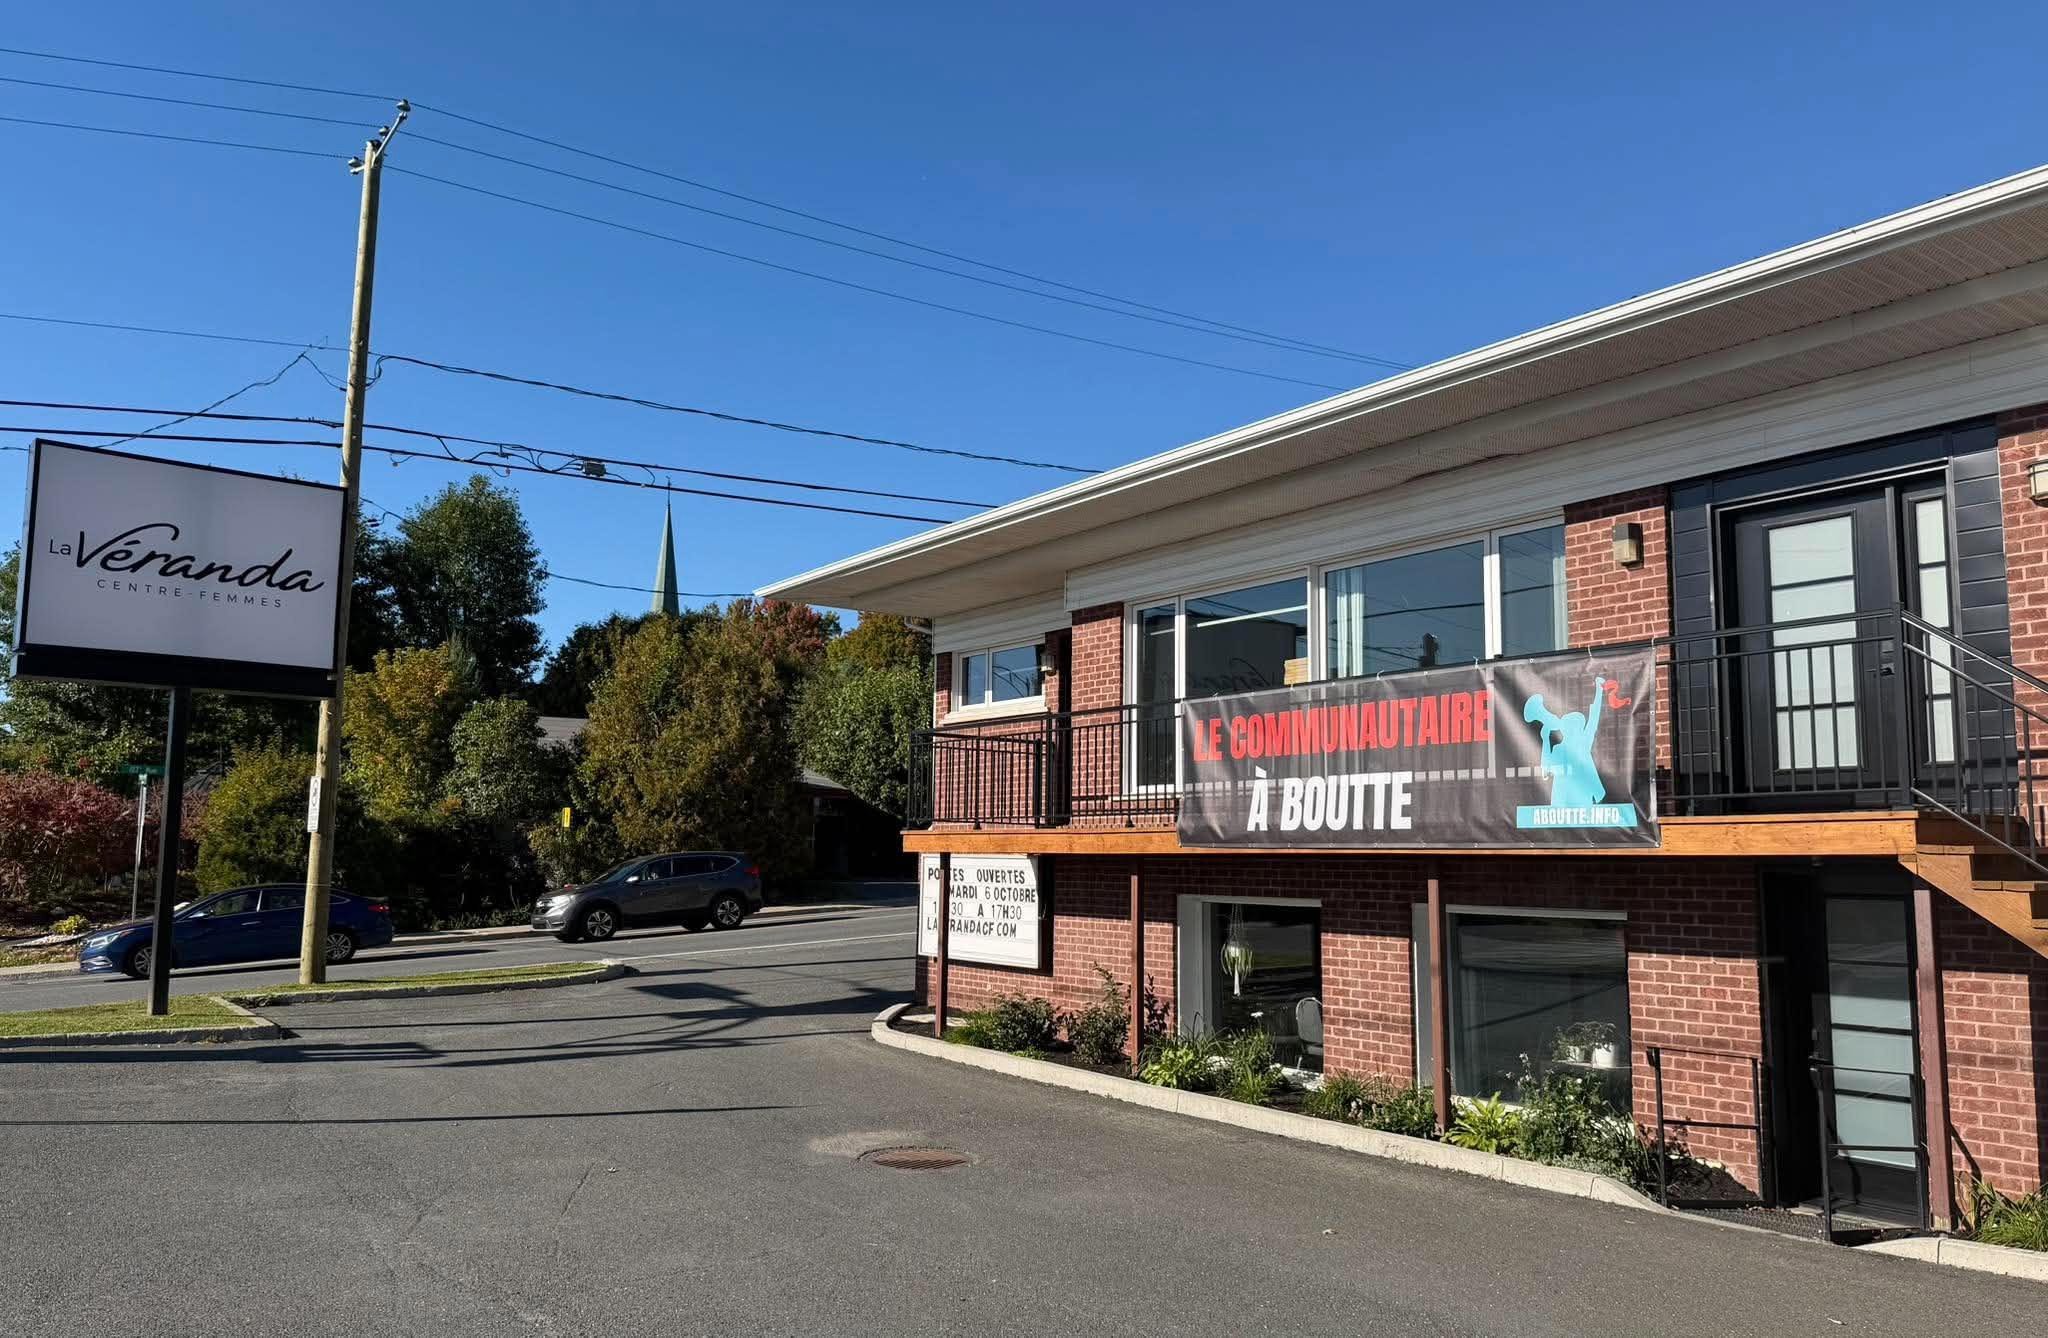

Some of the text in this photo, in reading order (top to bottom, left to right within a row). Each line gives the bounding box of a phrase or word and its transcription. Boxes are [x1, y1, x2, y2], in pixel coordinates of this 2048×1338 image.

[49, 522, 325, 594] La Véranda
[1193, 689, 1490, 762] LE COMMUNAUTAIRE
[1246, 765, 1413, 832] À BOUTTE
[1533, 807, 1620, 825] ABOUTTE.INFO
[928, 867, 1025, 885] POES OUVERTES
[984, 886, 991, 900] 6
[993, 887, 1036, 903] OCTOBRE
[977, 903, 985, 918] A
[991, 904, 1022, 921] 17H30
